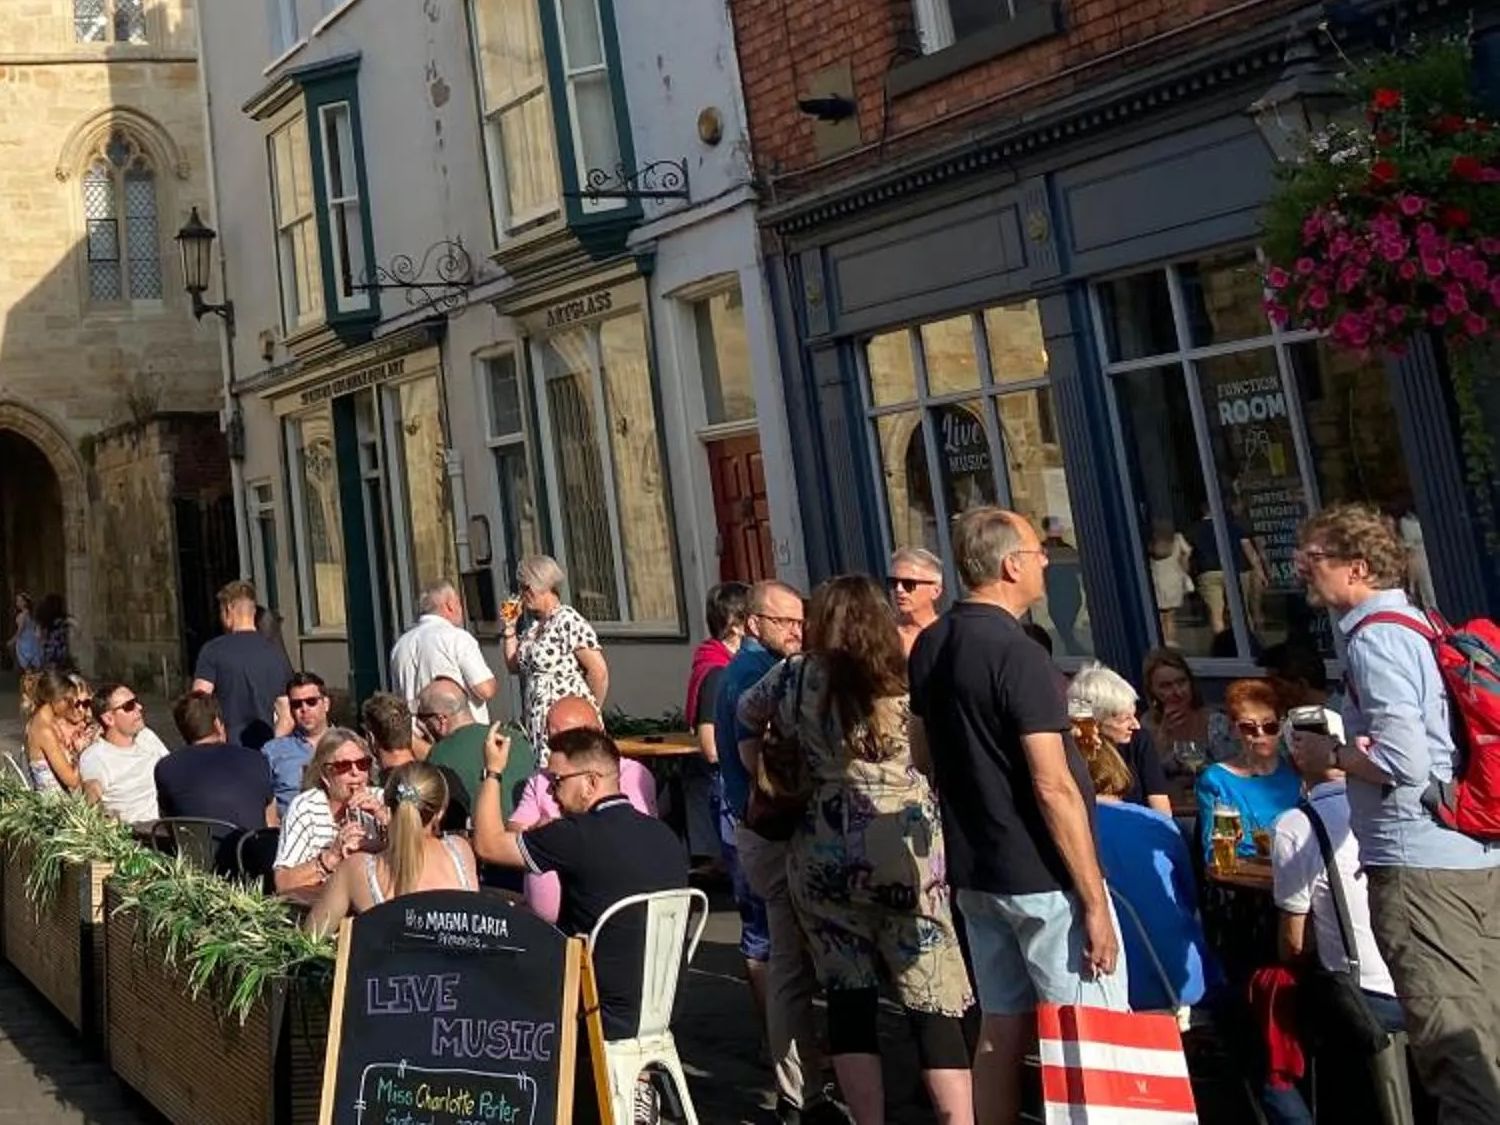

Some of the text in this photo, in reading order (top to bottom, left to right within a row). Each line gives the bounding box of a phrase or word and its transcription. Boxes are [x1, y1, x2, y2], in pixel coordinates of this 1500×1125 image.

[1219, 392, 1287, 426] ROOM
[948, 453, 991, 473] MUSIC
[425, 911, 469, 932] MAGNA
[471, 914, 509, 938] CARTA
[367, 973, 460, 1015] LIVE
[431, 1016, 555, 1061] MUSIC
[376, 1076, 413, 1106] Miss
[415, 1083, 475, 1117] Charlotte
